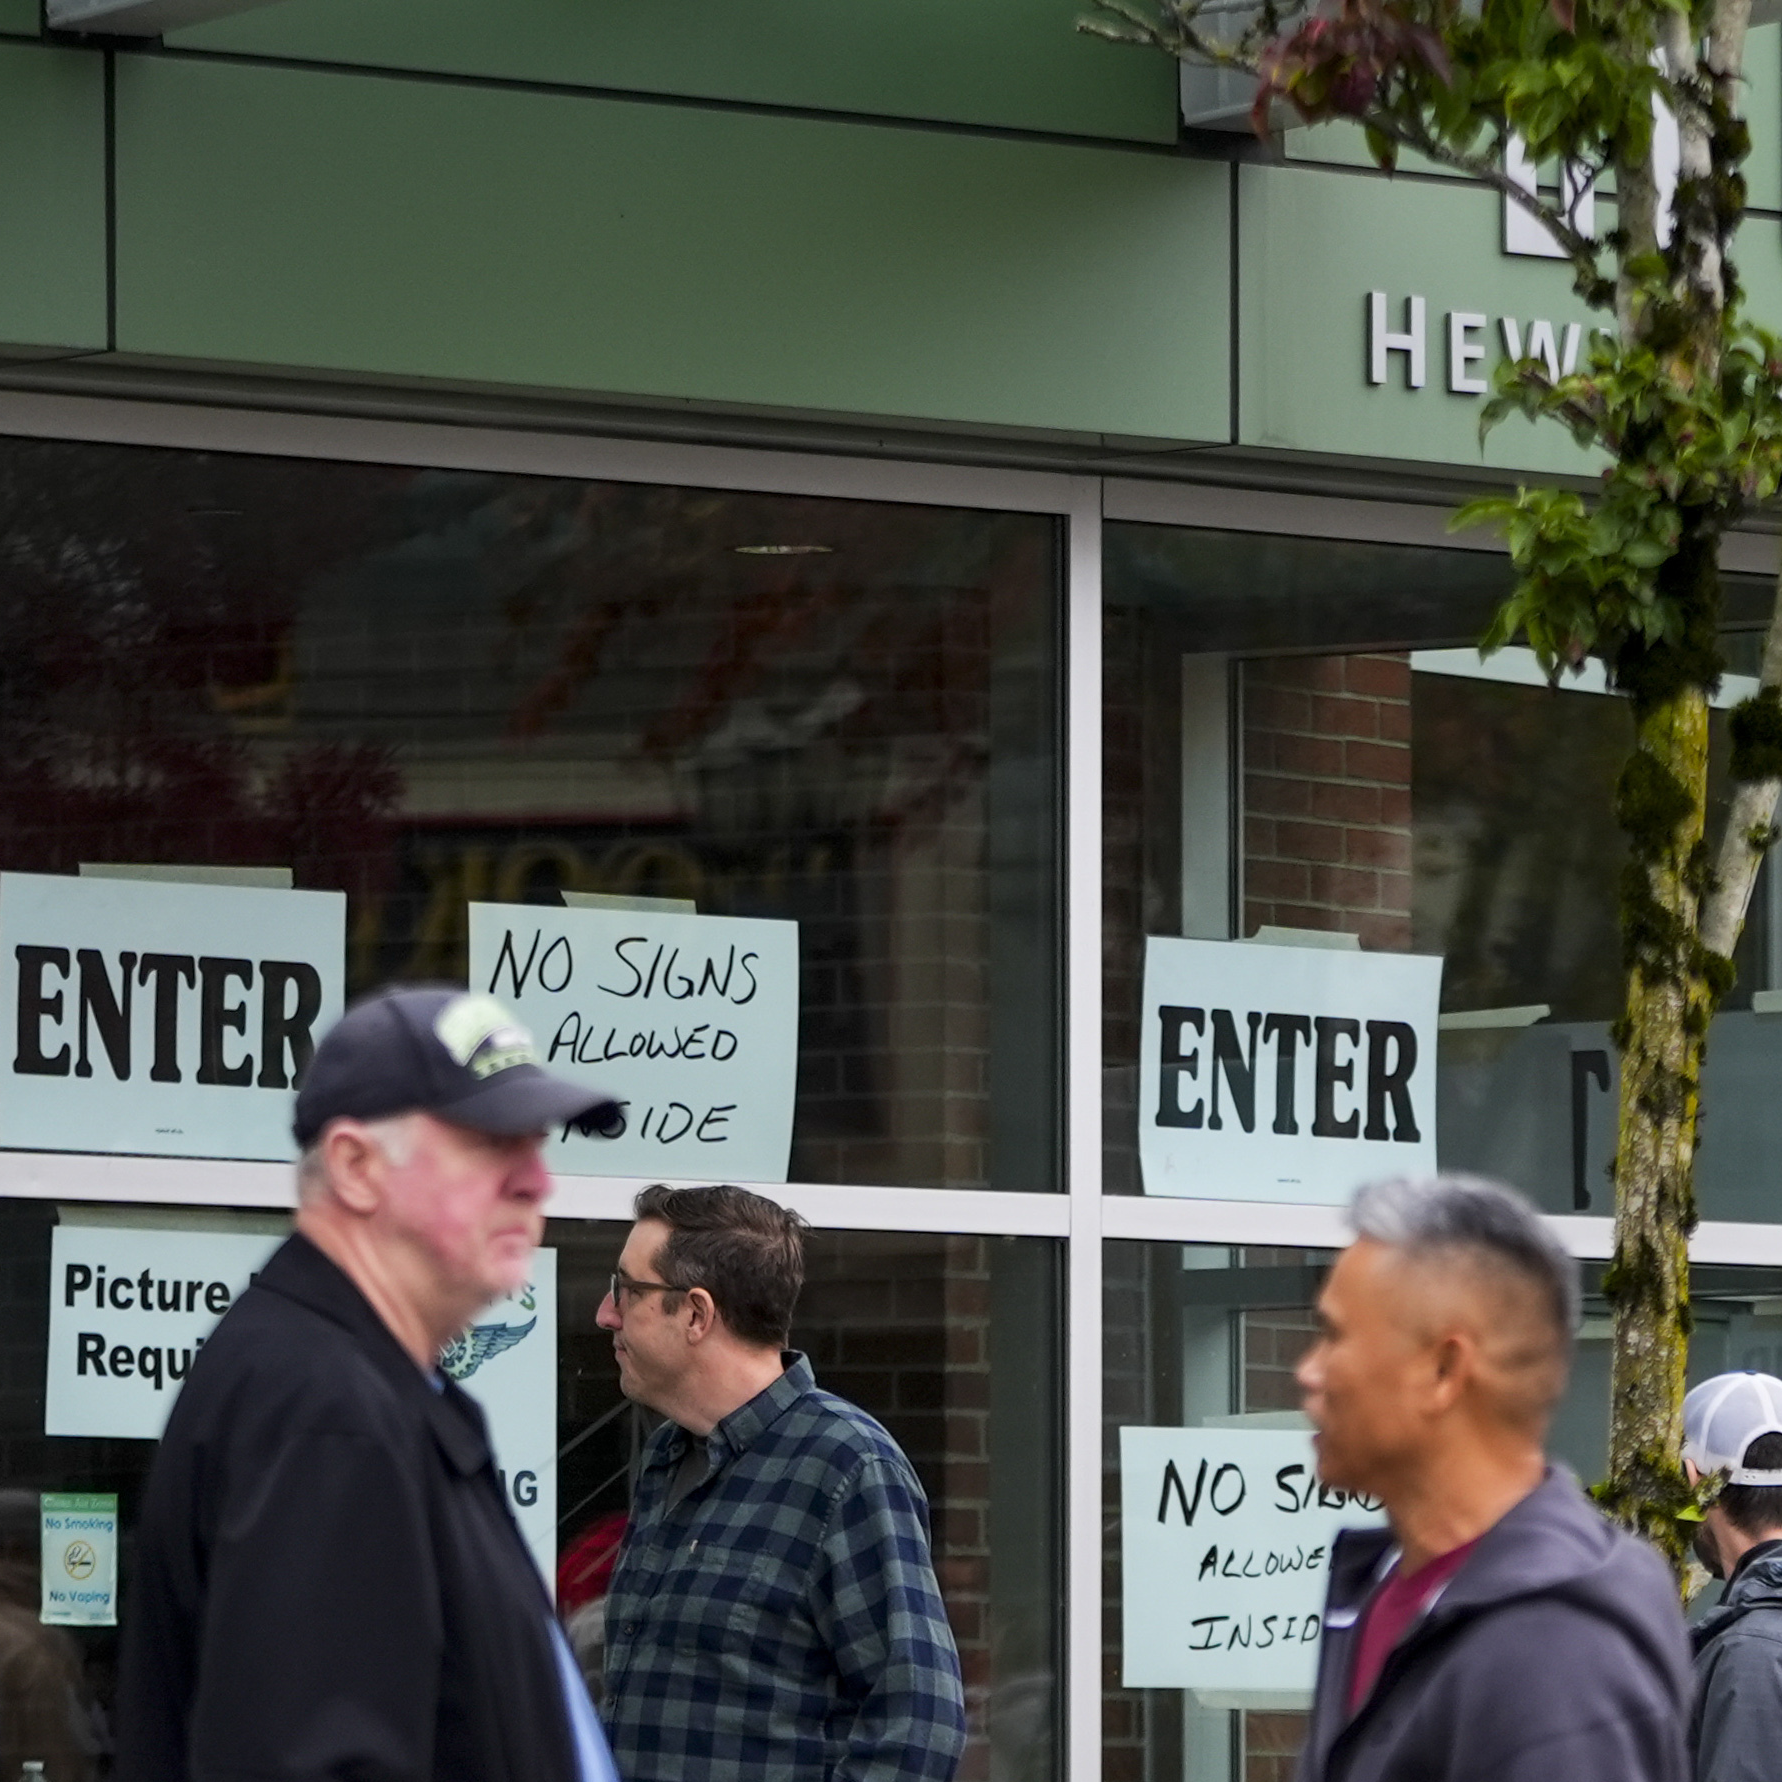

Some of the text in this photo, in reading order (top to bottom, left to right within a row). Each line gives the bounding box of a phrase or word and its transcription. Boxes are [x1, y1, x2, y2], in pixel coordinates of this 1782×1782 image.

[1367, 289, 1613, 396] HEW
[489, 928, 759, 1005] NO SIGNS
[13, 944, 322, 1093] ENTER
[547, 1010, 738, 1065] ALLOWED
[1155, 1004, 1421, 1144] ENTER
[65, 1263, 230, 1316] Picture
[1158, 1458, 1247, 1527] NO
[46, 1518, 114, 1533] No Smoking
[1198, 1544, 1334, 1581] ALLOWE
[49, 1591, 110, 1605] No Vaping
